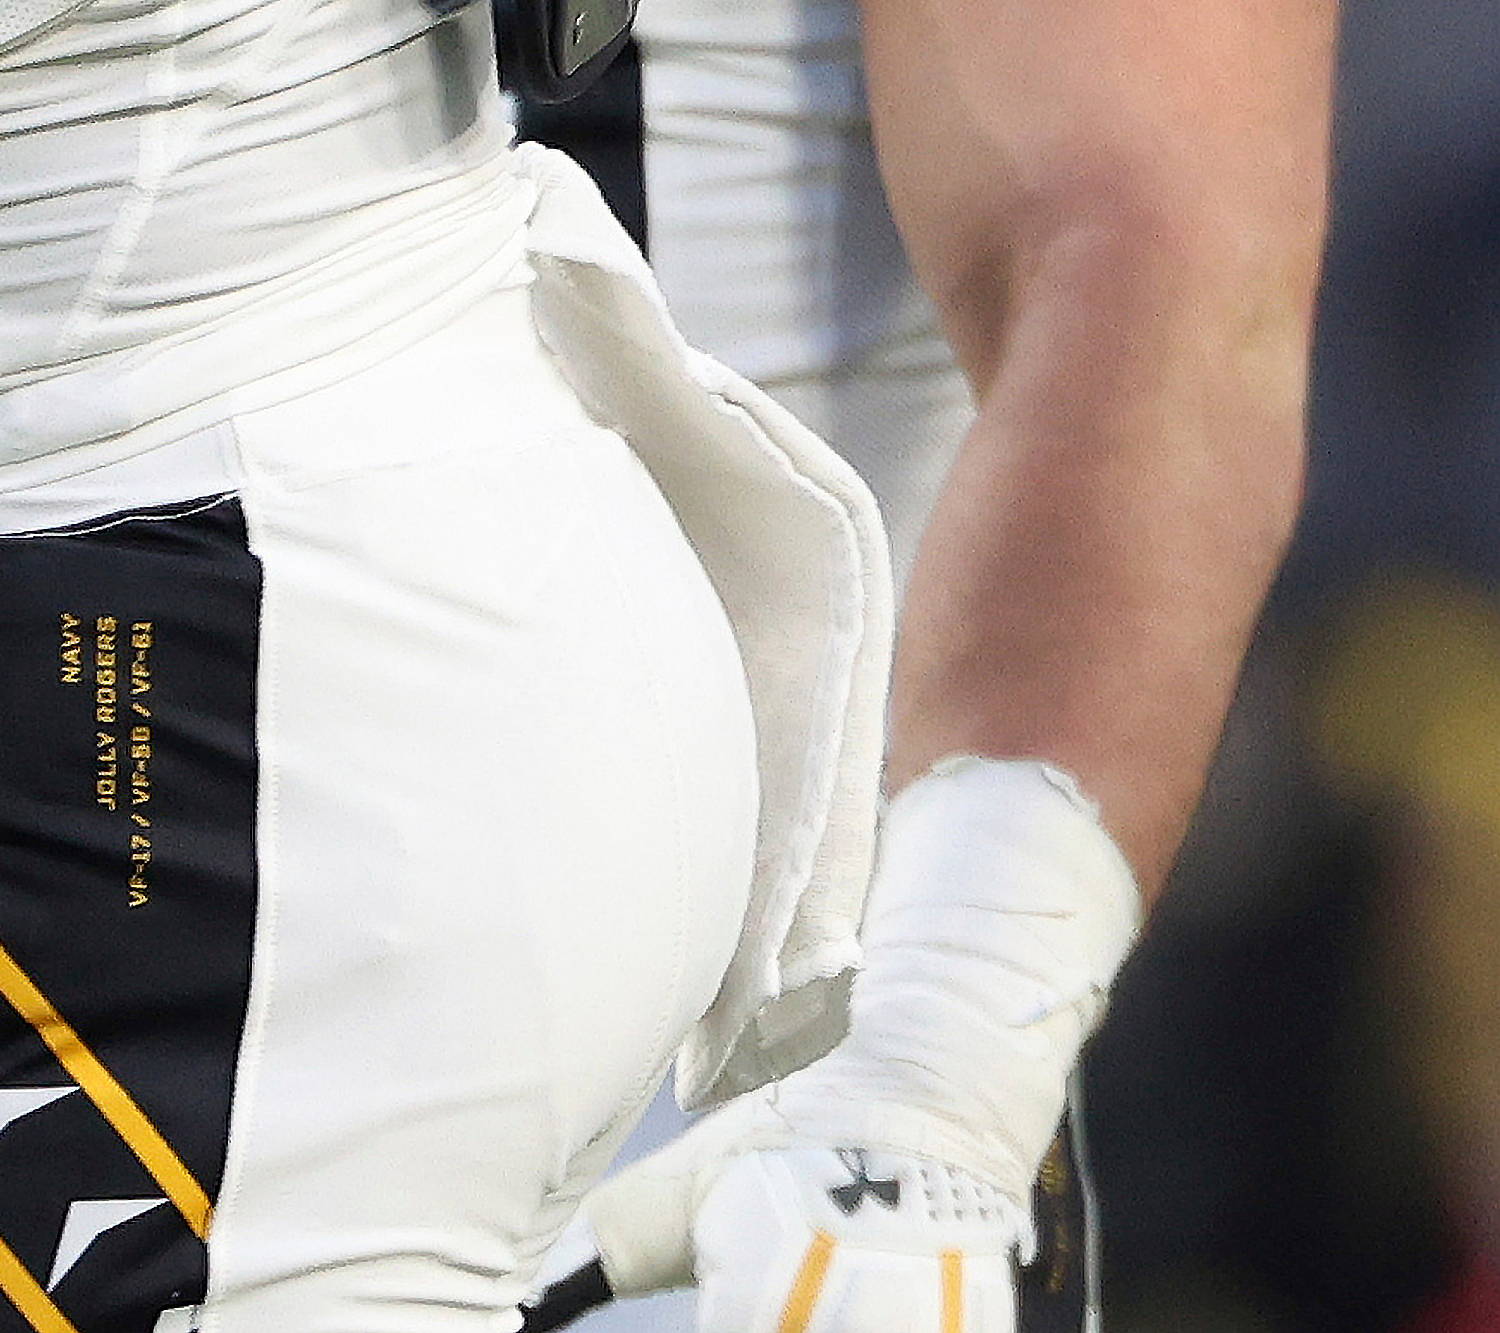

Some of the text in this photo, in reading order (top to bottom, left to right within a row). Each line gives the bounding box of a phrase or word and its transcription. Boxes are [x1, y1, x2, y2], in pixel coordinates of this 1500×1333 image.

[59, 611, 83, 686] NAVY
[96, 615, 118, 812] JOLLY ROGERS
